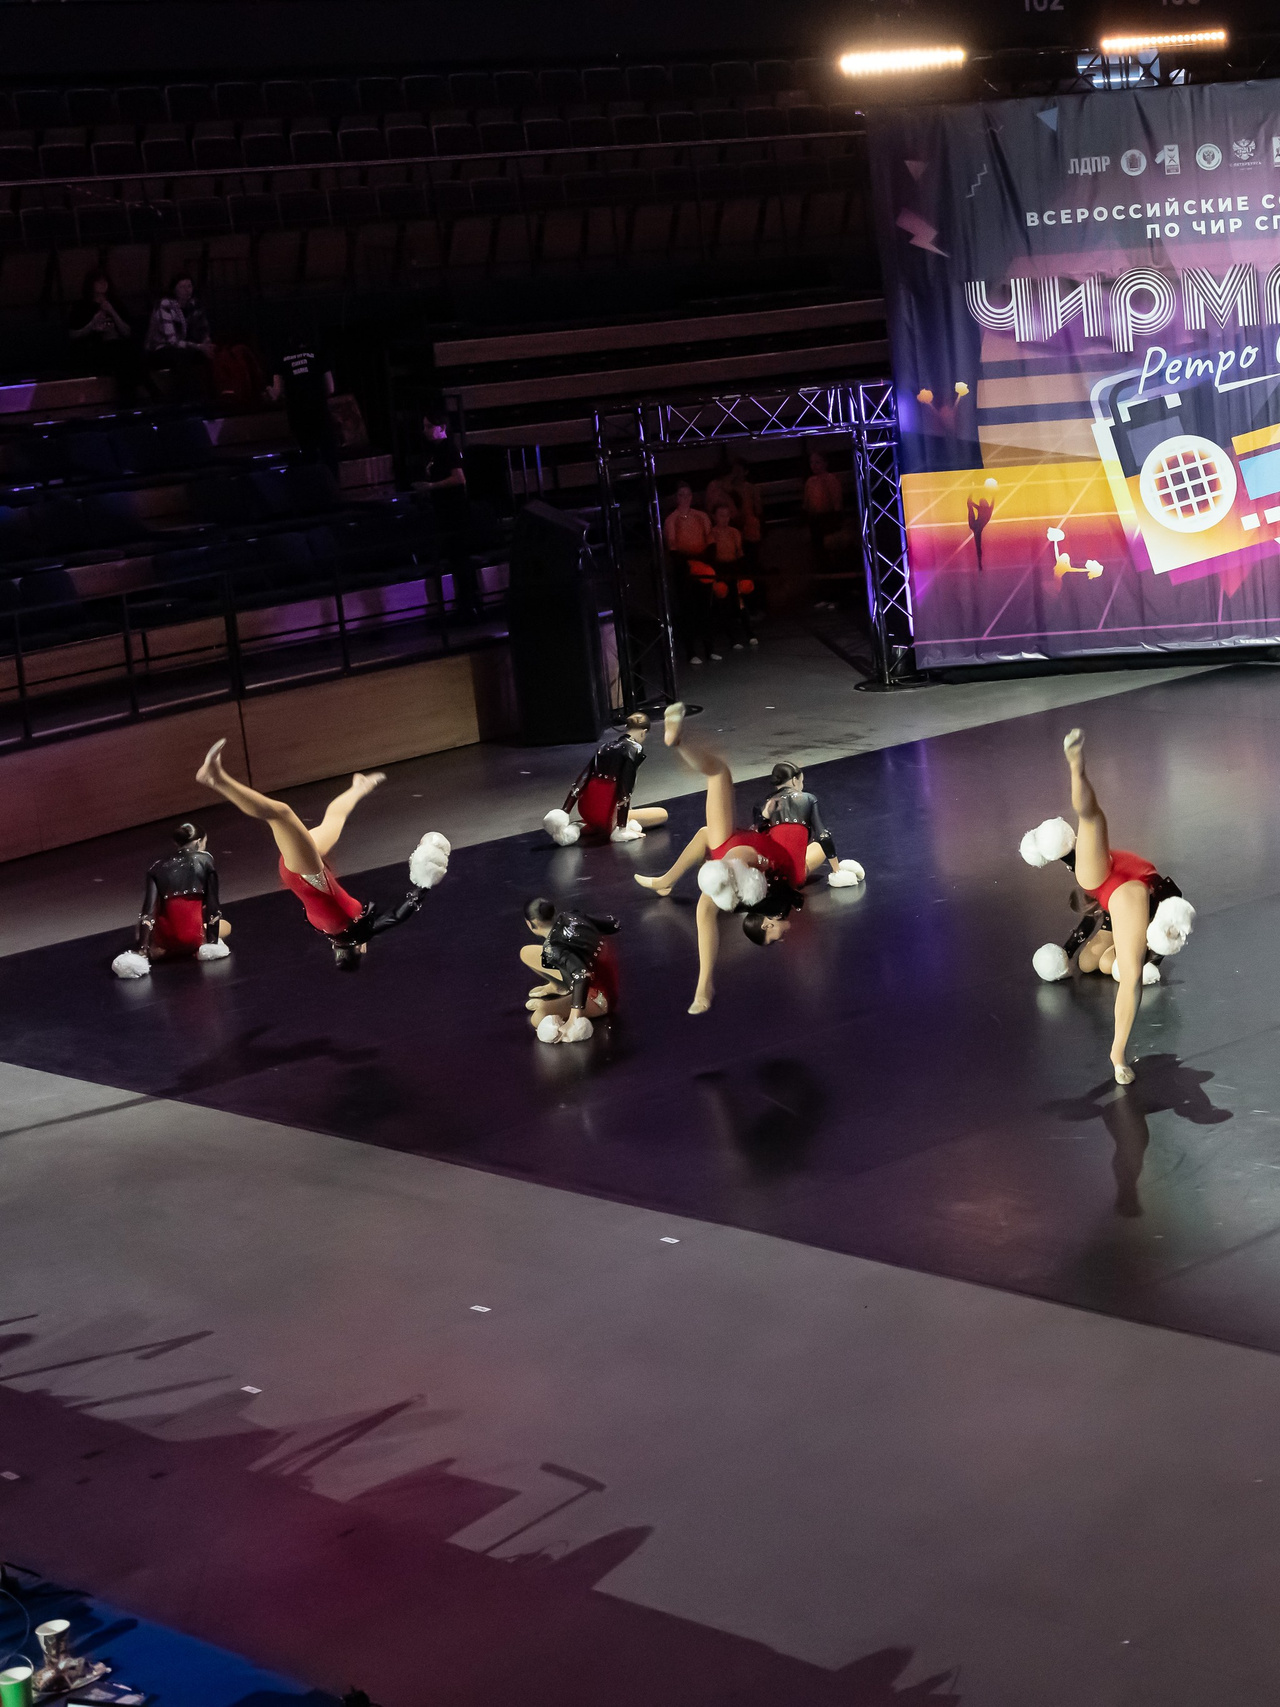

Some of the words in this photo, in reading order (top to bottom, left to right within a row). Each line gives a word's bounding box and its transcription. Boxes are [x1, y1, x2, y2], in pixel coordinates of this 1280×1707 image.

[1068, 155, 1111, 176] ЛДПР
[1026, 196, 1249, 227] ВСЕРОССИЙСКИЕ
[1146, 222, 1180, 239] ПО
[1192, 218, 1243, 235] ЧИР
[1137, 345, 1259, 395] Ретро
